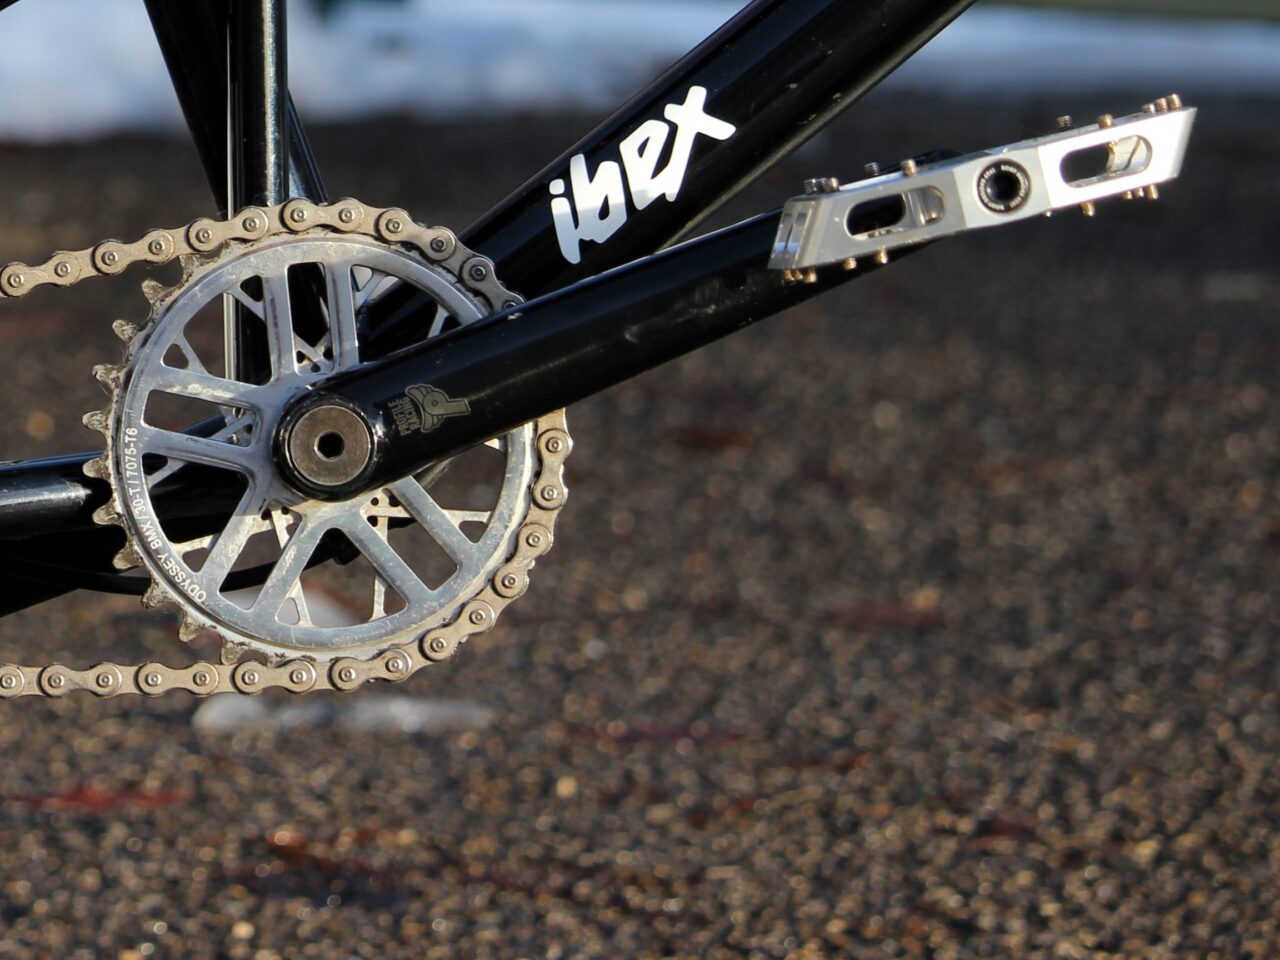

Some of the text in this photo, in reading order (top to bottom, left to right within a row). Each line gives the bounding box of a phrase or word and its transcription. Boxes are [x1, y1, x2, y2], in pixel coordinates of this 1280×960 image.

[549, 85, 737, 265] ibex
[387, 398, 412, 437] PROFILE
[400, 396, 421, 431] RACING
[125, 427, 139, 478] 7075-T6
[141, 520, 163, 550] BMX
[157, 553, 207, 602] ODYSSEY
